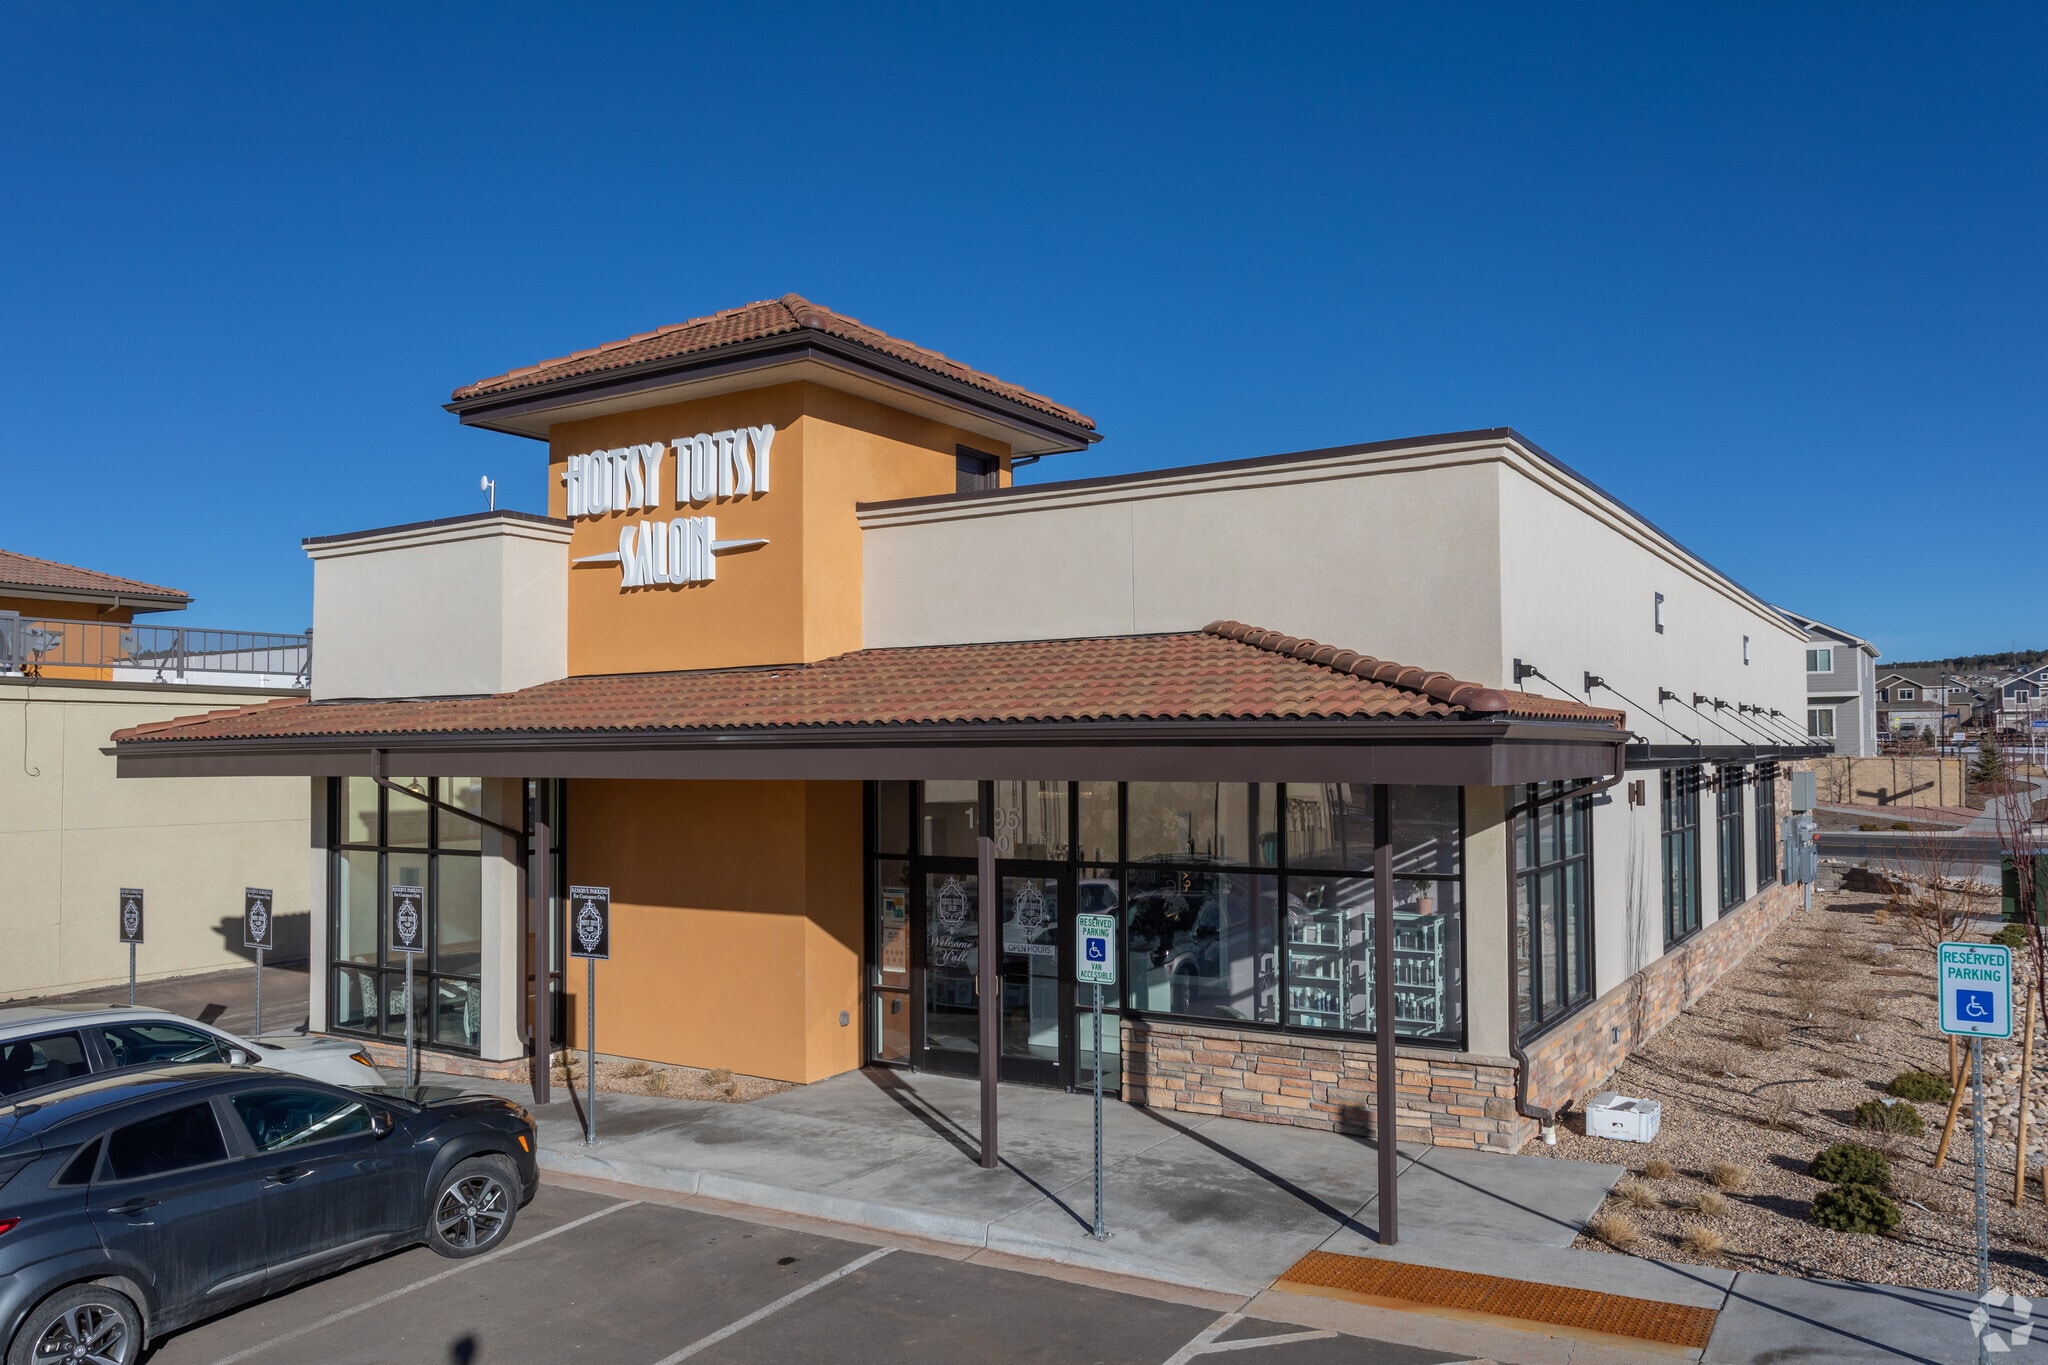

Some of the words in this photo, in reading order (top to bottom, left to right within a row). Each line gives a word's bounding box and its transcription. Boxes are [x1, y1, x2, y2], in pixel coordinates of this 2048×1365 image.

[561, 442, 665, 516] HOTSY
[671, 424, 776, 503] TOTSY
[619, 516, 716, 587] SALON
[965, 807, 1020, 830] 195
[1080, 917, 1112, 928] RESERVED
[1082, 927, 1110, 938] PARKING
[927, 935, 973, 949] Welcome
[1008, 944, 1027, 952] OPEN
[1027, 945, 1051, 954] HOURS
[1943, 951, 2005, 966] RESERVED
[1081, 970, 1113, 980] ACCESSIBLE
[1948, 967, 2001, 982] PARKING
